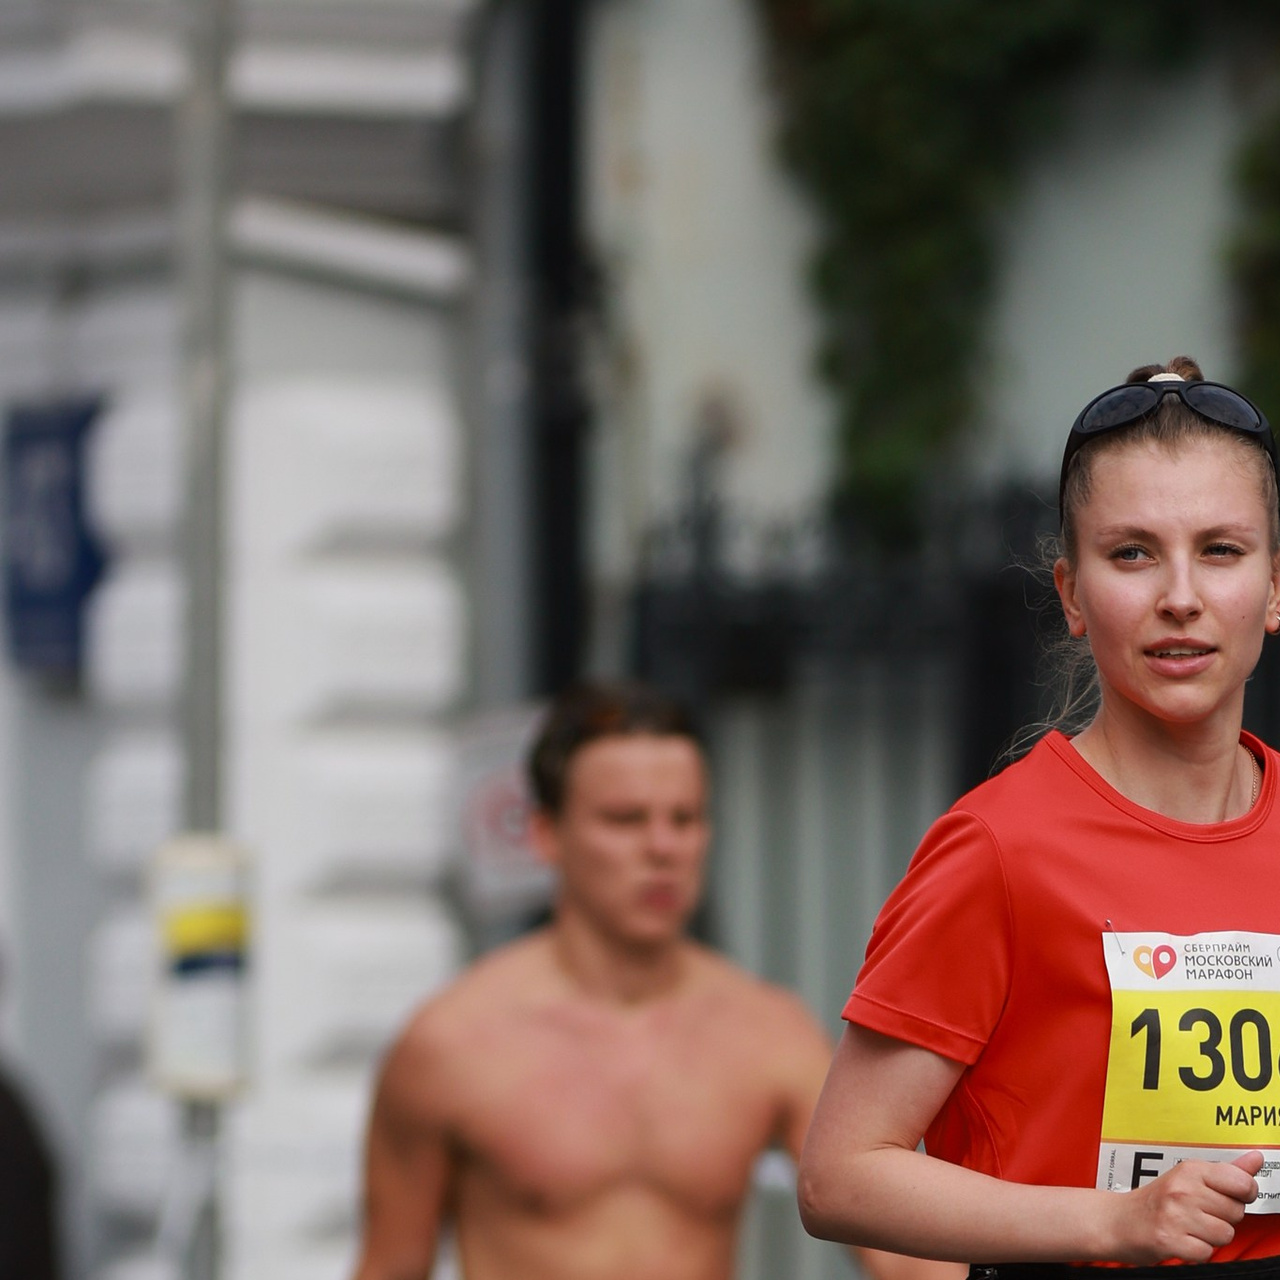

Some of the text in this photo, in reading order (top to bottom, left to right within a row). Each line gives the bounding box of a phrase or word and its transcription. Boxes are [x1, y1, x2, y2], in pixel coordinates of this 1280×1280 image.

[1184, 942, 1251, 953] СБЕРПРАЙМ
[1185, 954, 1273, 968] МОСКОВСКИЙ
[1186, 968, 1253, 980] МАРАФОН
